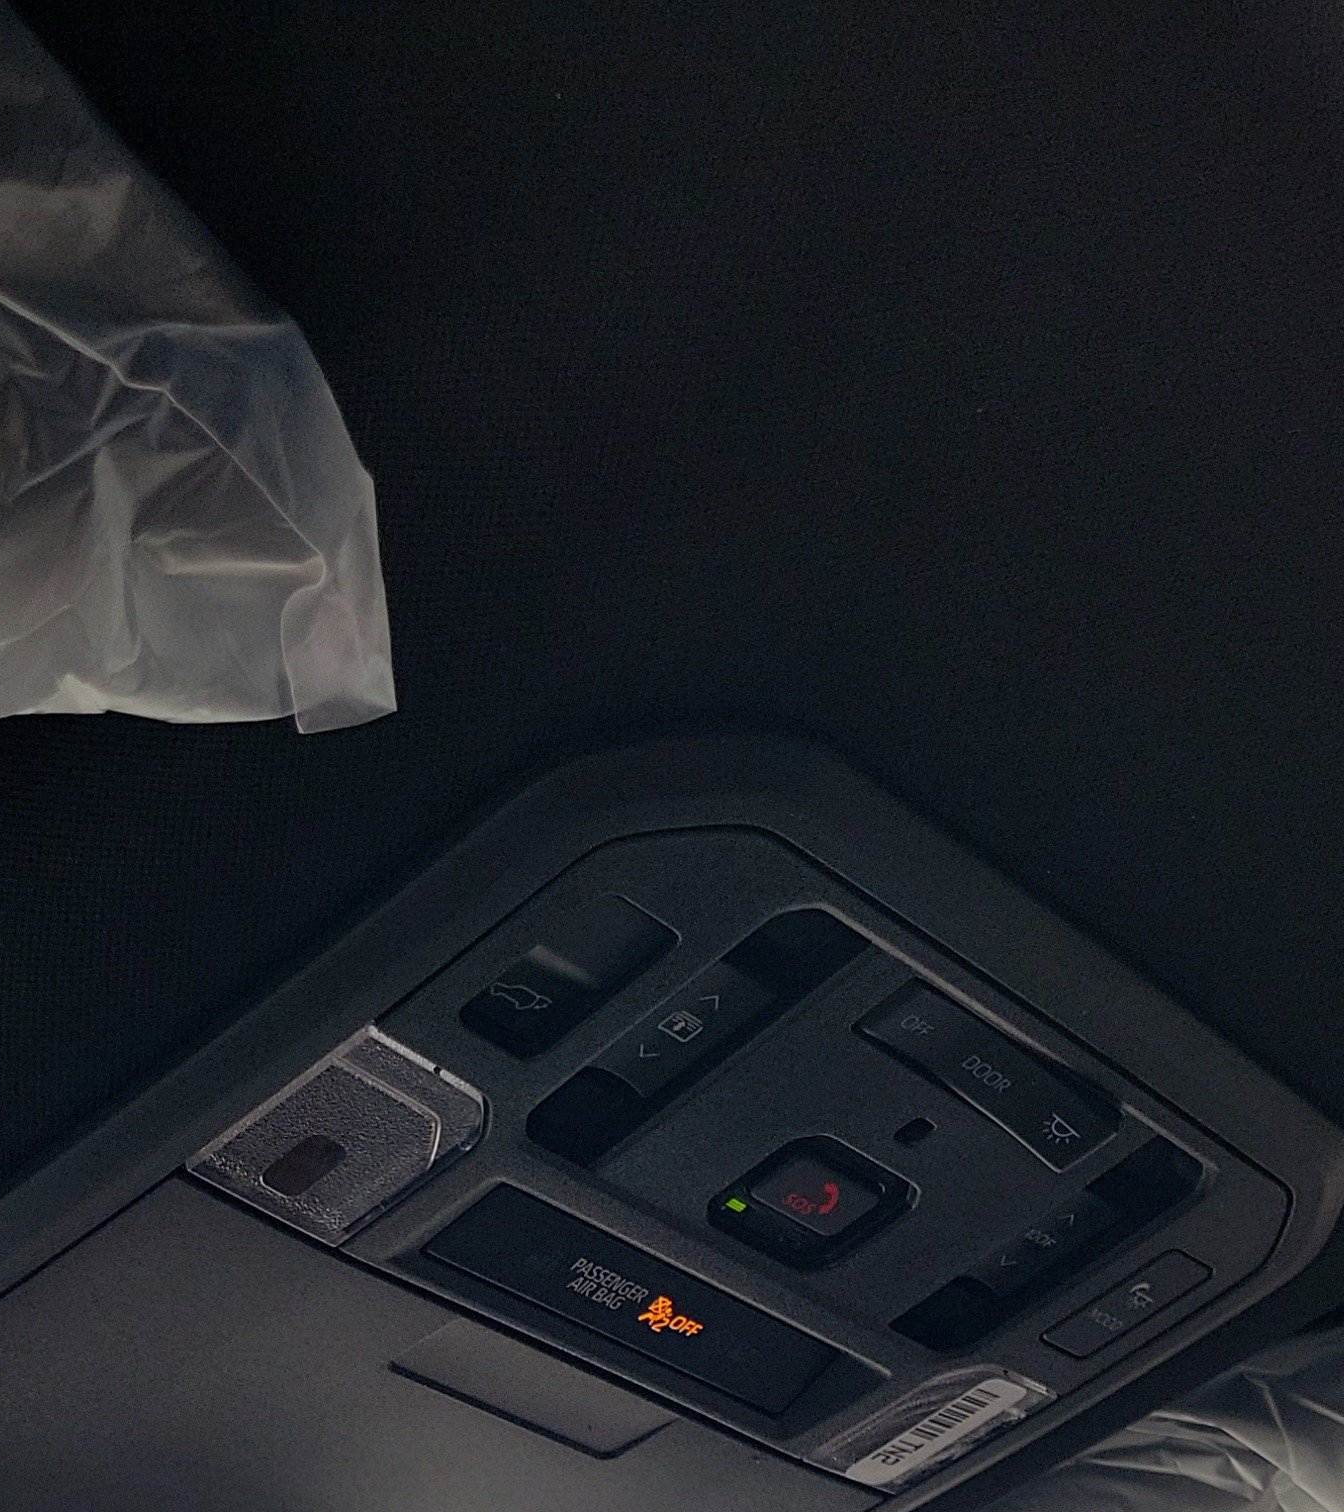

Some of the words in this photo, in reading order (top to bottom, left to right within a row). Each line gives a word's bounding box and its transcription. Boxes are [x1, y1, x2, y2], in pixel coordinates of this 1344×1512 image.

[961, 1055, 1012, 1094] DOOR
[566, 1277, 596, 1298] AIR
[591, 1288, 626, 1311] BAG
[570, 1257, 649, 1304] PASSENGER
[668, 1314, 705, 1338] OFF
